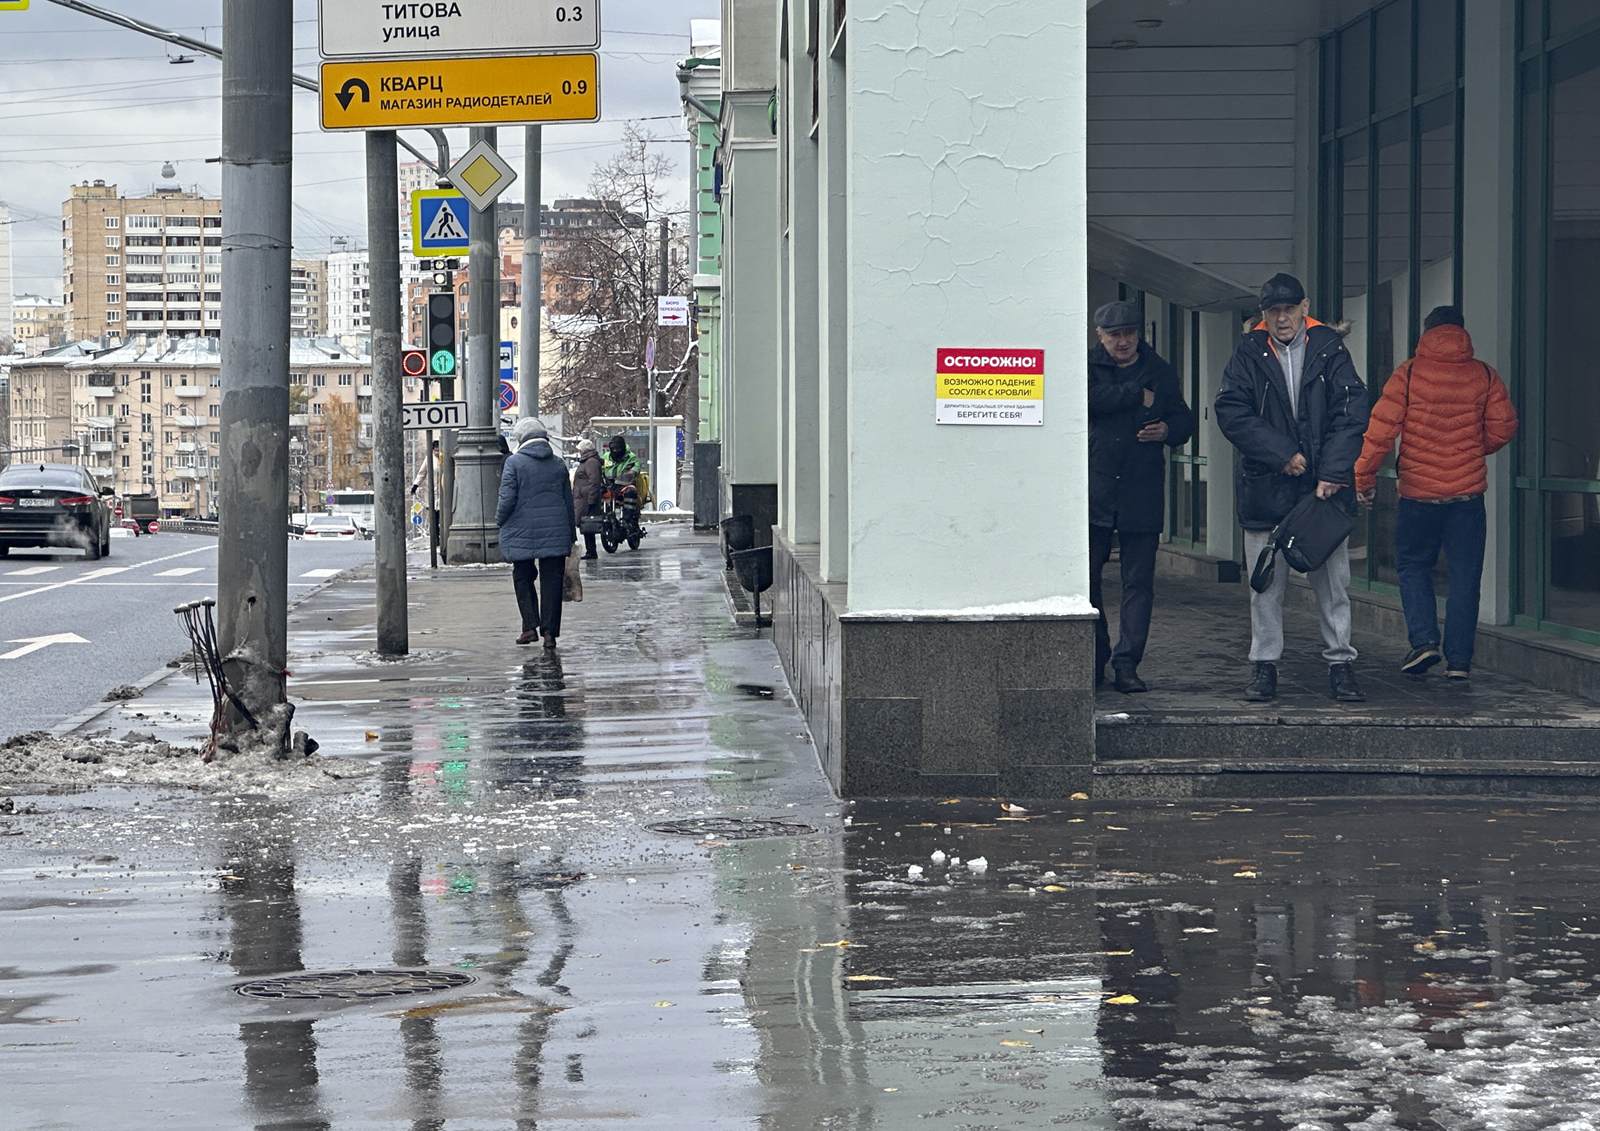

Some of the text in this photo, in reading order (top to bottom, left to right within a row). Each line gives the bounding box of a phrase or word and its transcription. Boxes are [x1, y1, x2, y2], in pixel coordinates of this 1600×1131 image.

[382, 2, 462, 20] ТИТОВА
[556, 6, 583, 22] 0.3
[382, 25, 440, 42] улица
[380, 75, 443, 92] КВАРЦ
[561, 80, 588, 95] 0.9
[380, 91, 552, 110] МАГАЗИН РАДИОДЕТАЛЕЙ
[944, 356, 1036, 367] ОСТОРОЖНО!
[944, 378, 1036, 387] ВОЗМОЖНО ПАДЕНИЕ
[948, 388, 986, 396] СОСУЛЕК
[988, 388, 994, 396] С
[999, 411, 1023, 419] СЕБЯ!
